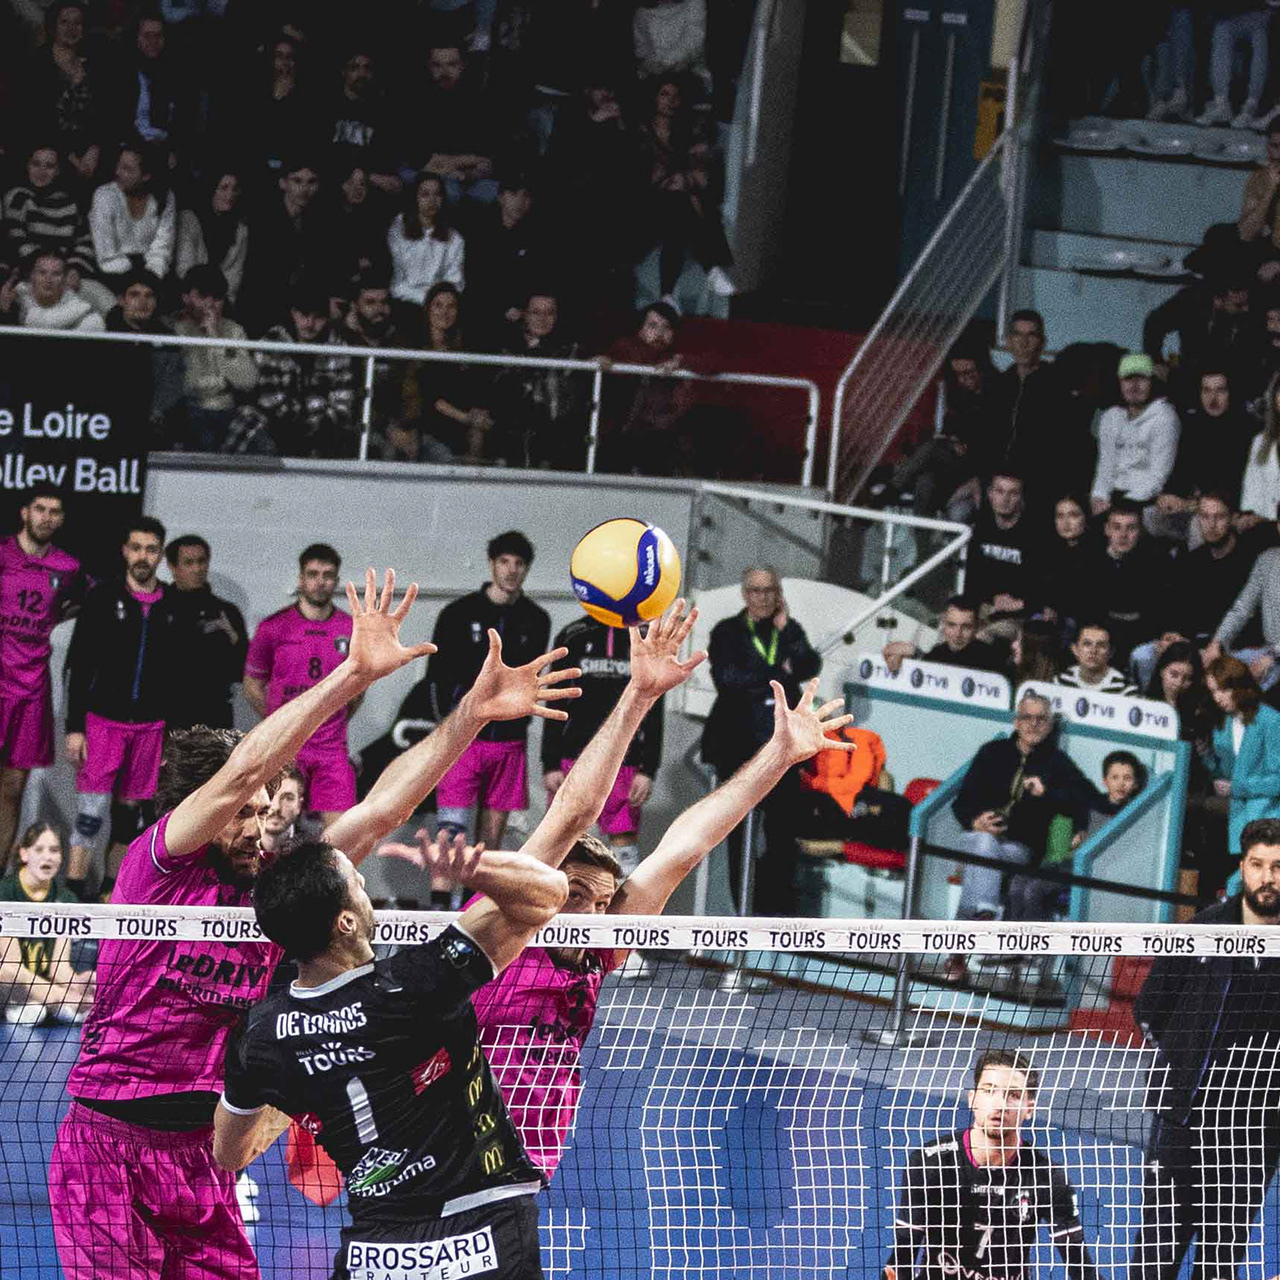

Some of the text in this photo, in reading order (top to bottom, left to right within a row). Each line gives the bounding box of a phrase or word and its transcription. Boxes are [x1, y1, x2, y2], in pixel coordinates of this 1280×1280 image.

[23, 403, 111, 440] Loire
[74, 458, 141, 494] Ball
[18, 589, 45, 614] 12
[308, 656, 323, 680] 8
[976, 682, 1001, 698] TVB
[27, 916, 91, 936] TOURS
[115, 918, 177, 937] TOURS
[200, 919, 263, 939] TOURS
[373, 922, 429, 942] TOURS
[535, 926, 591, 945] TOURS
[614, 928, 670, 946] TOURS
[691, 928, 748, 947] TOURS
[768, 930, 826, 949] TOURS
[848, 930, 901, 949] TOURS
[921, 932, 976, 950] TOURS
[996, 934, 1050, 952] TOURS
[1070, 934, 1122, 953] TOURS
[1141, 936, 1195, 954] TOURS
[1214, 937, 1266, 955] TOURS
[298, 1046, 376, 1076] TOURS
[345, 1075, 380, 1144] 1
[350, 1231, 490, 1270] BROSSARD
[973, 1222, 995, 1259] 7
